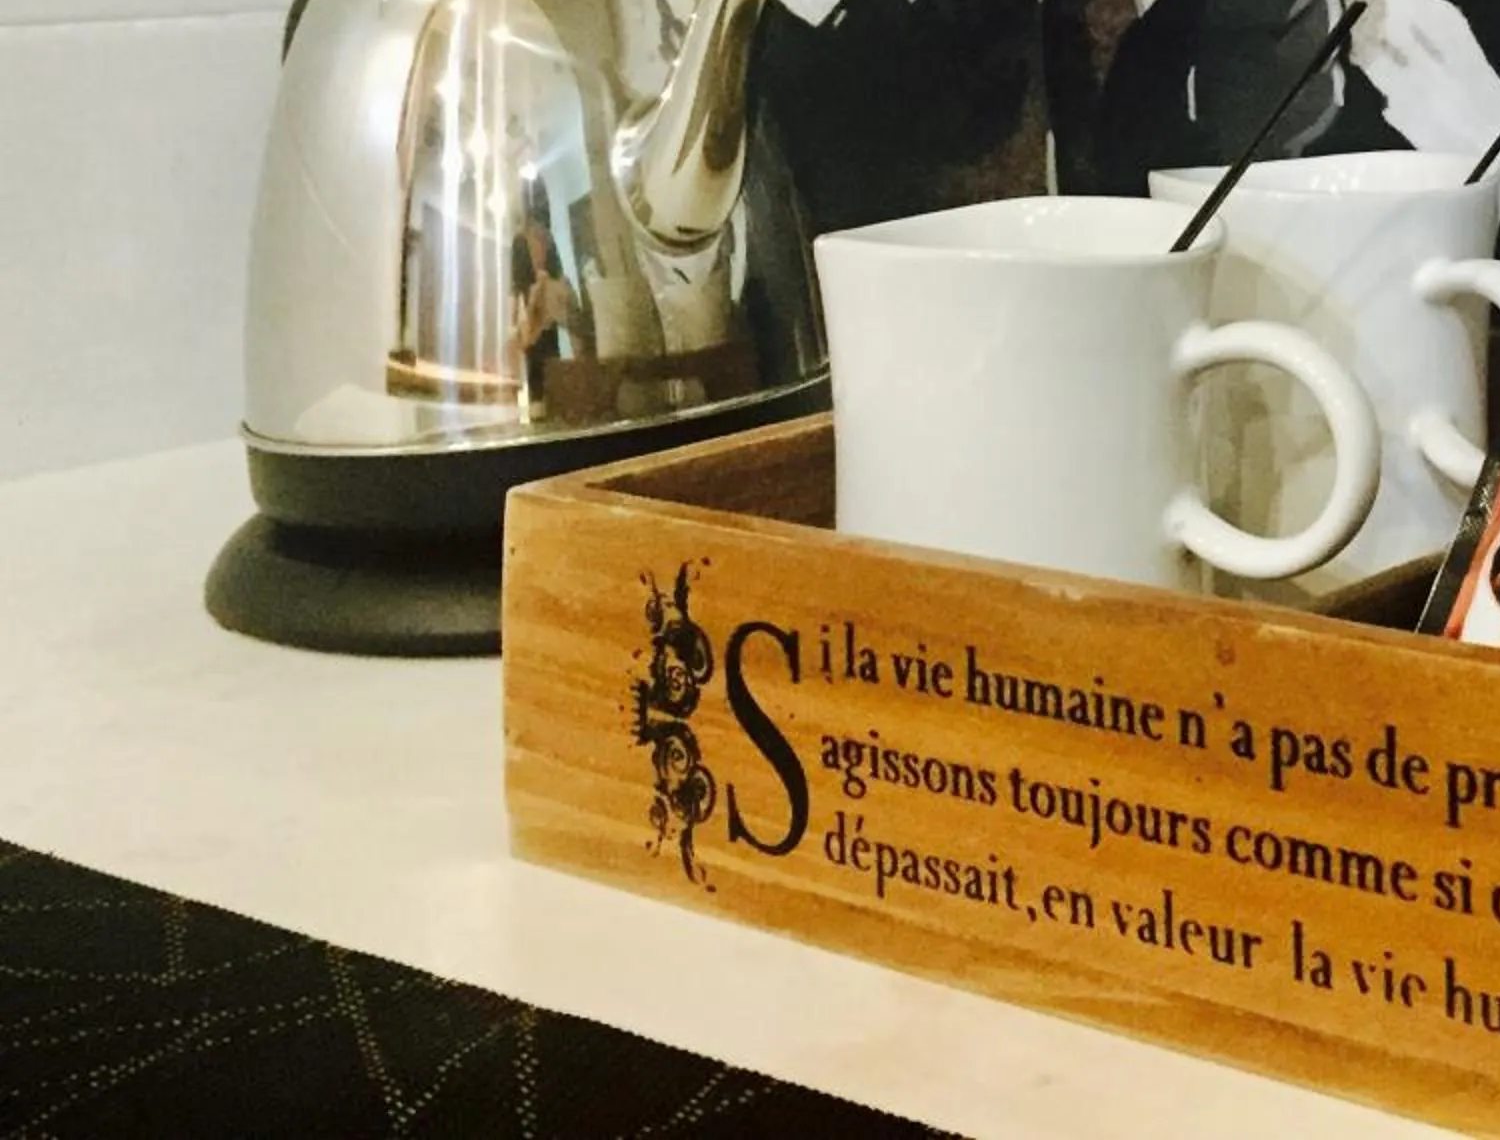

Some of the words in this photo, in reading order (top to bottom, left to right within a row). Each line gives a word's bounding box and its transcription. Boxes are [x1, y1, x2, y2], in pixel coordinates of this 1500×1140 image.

[843, 621, 880, 685] la
[891, 643, 954, 699] vie
[964, 645, 1165, 742] humaine
[1270, 726, 1353, 792] pas
[1365, 724, 1430, 795] de
[821, 728, 998, 807] agissons
[1008, 767, 1212, 855] toujours
[1225, 824, 1419, 902] comme
[1433, 857, 1474, 915] si
[1111, 889, 1263, 969] valeur
[1291, 919, 1333, 991] la
